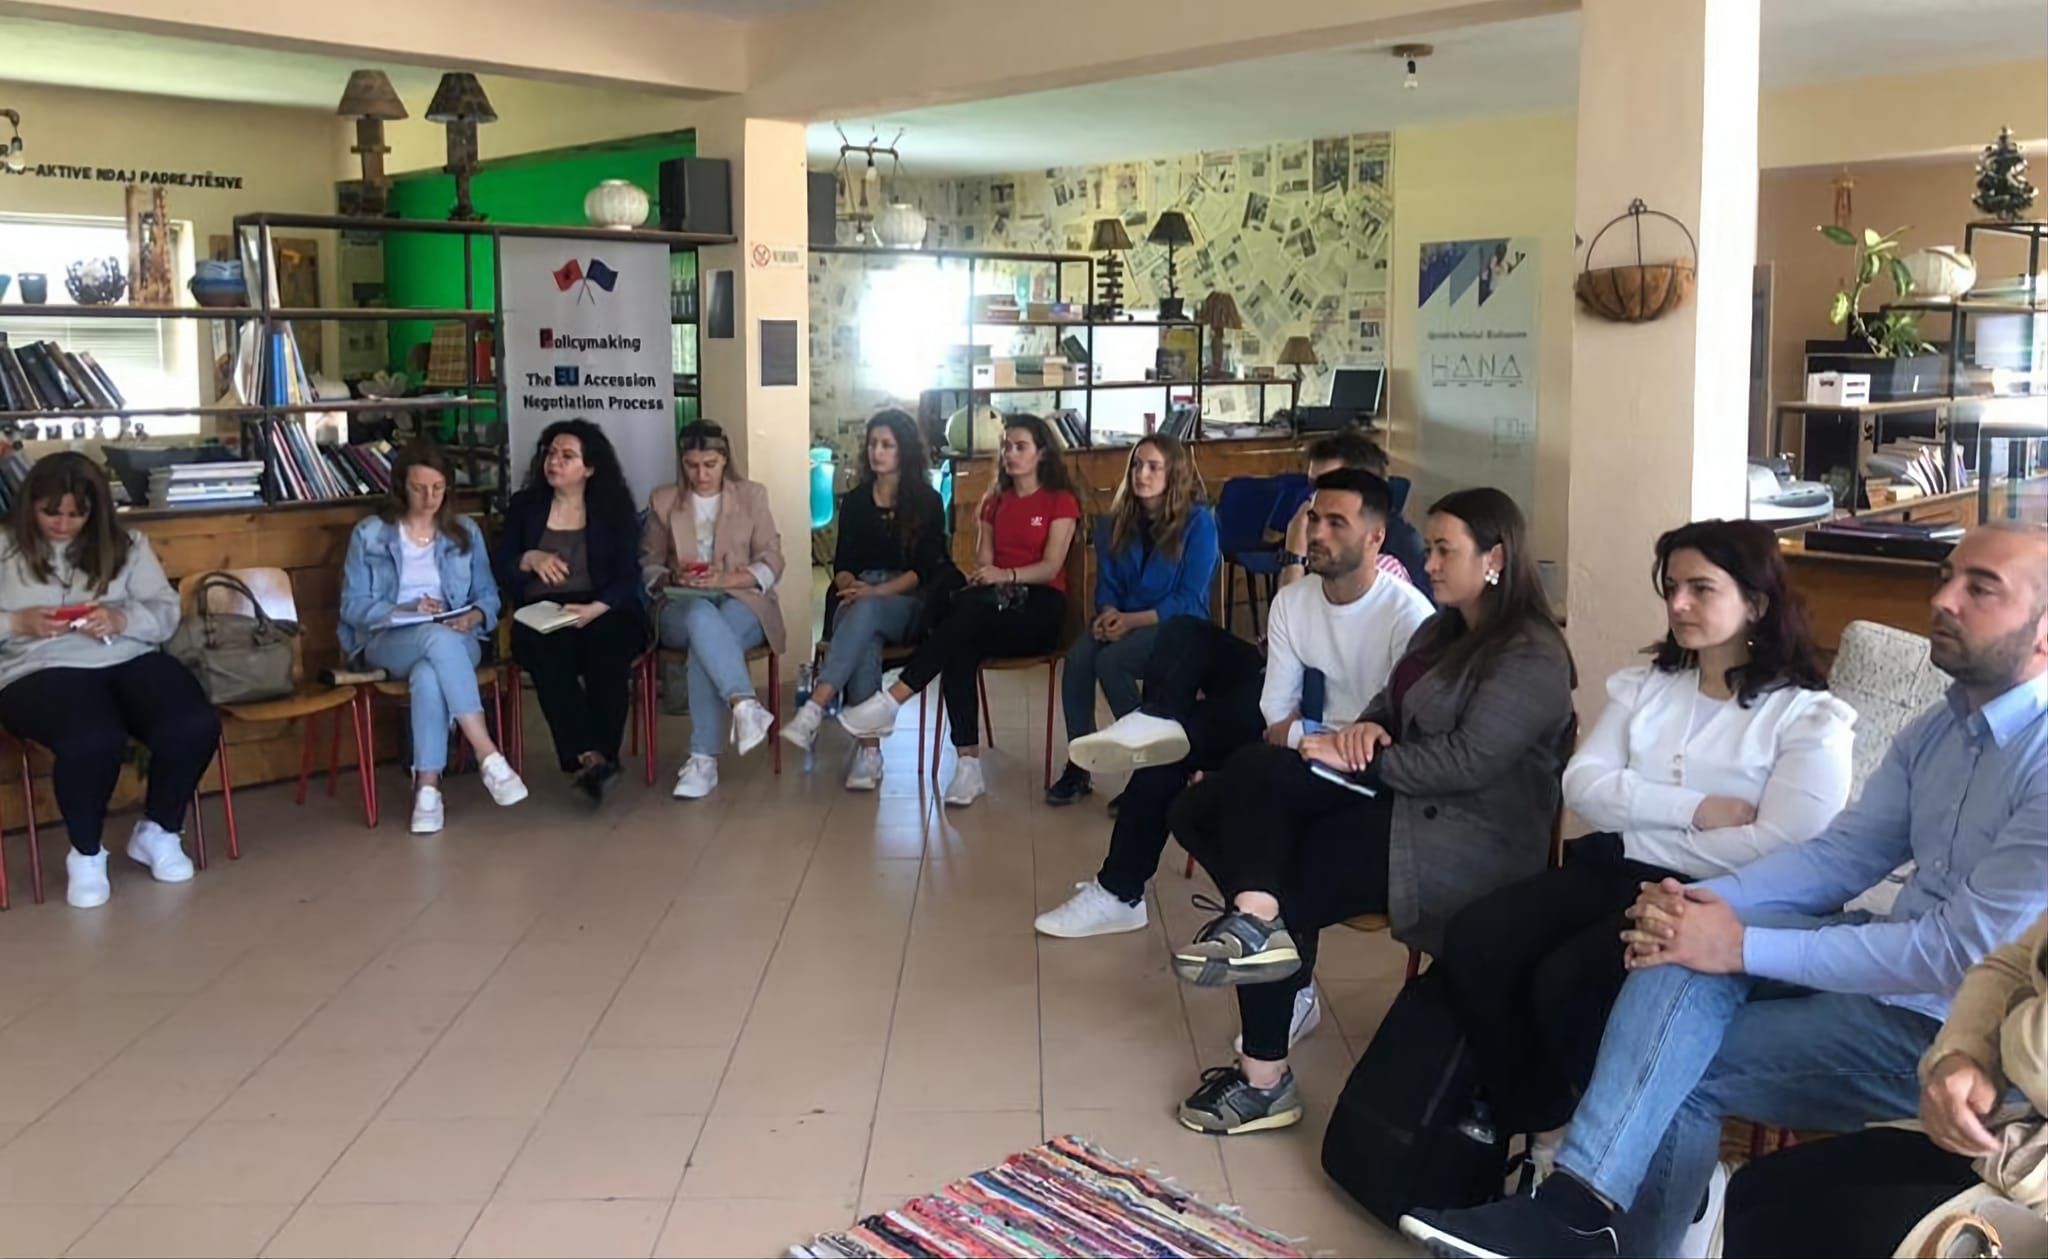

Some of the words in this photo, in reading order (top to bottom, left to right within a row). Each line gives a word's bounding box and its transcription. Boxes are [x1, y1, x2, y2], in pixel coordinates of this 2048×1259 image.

[96, 168, 136, 183] NDAJ
[140, 170, 243, 190] PADREJTËSIVE
[540, 328, 641, 352] Policymaking
[526, 373, 552, 387] The
[556, 367, 578, 386] EU
[584, 373, 656, 387] Accession
[523, 395, 604, 411] Negotiation
[609, 396, 664, 410] Process
